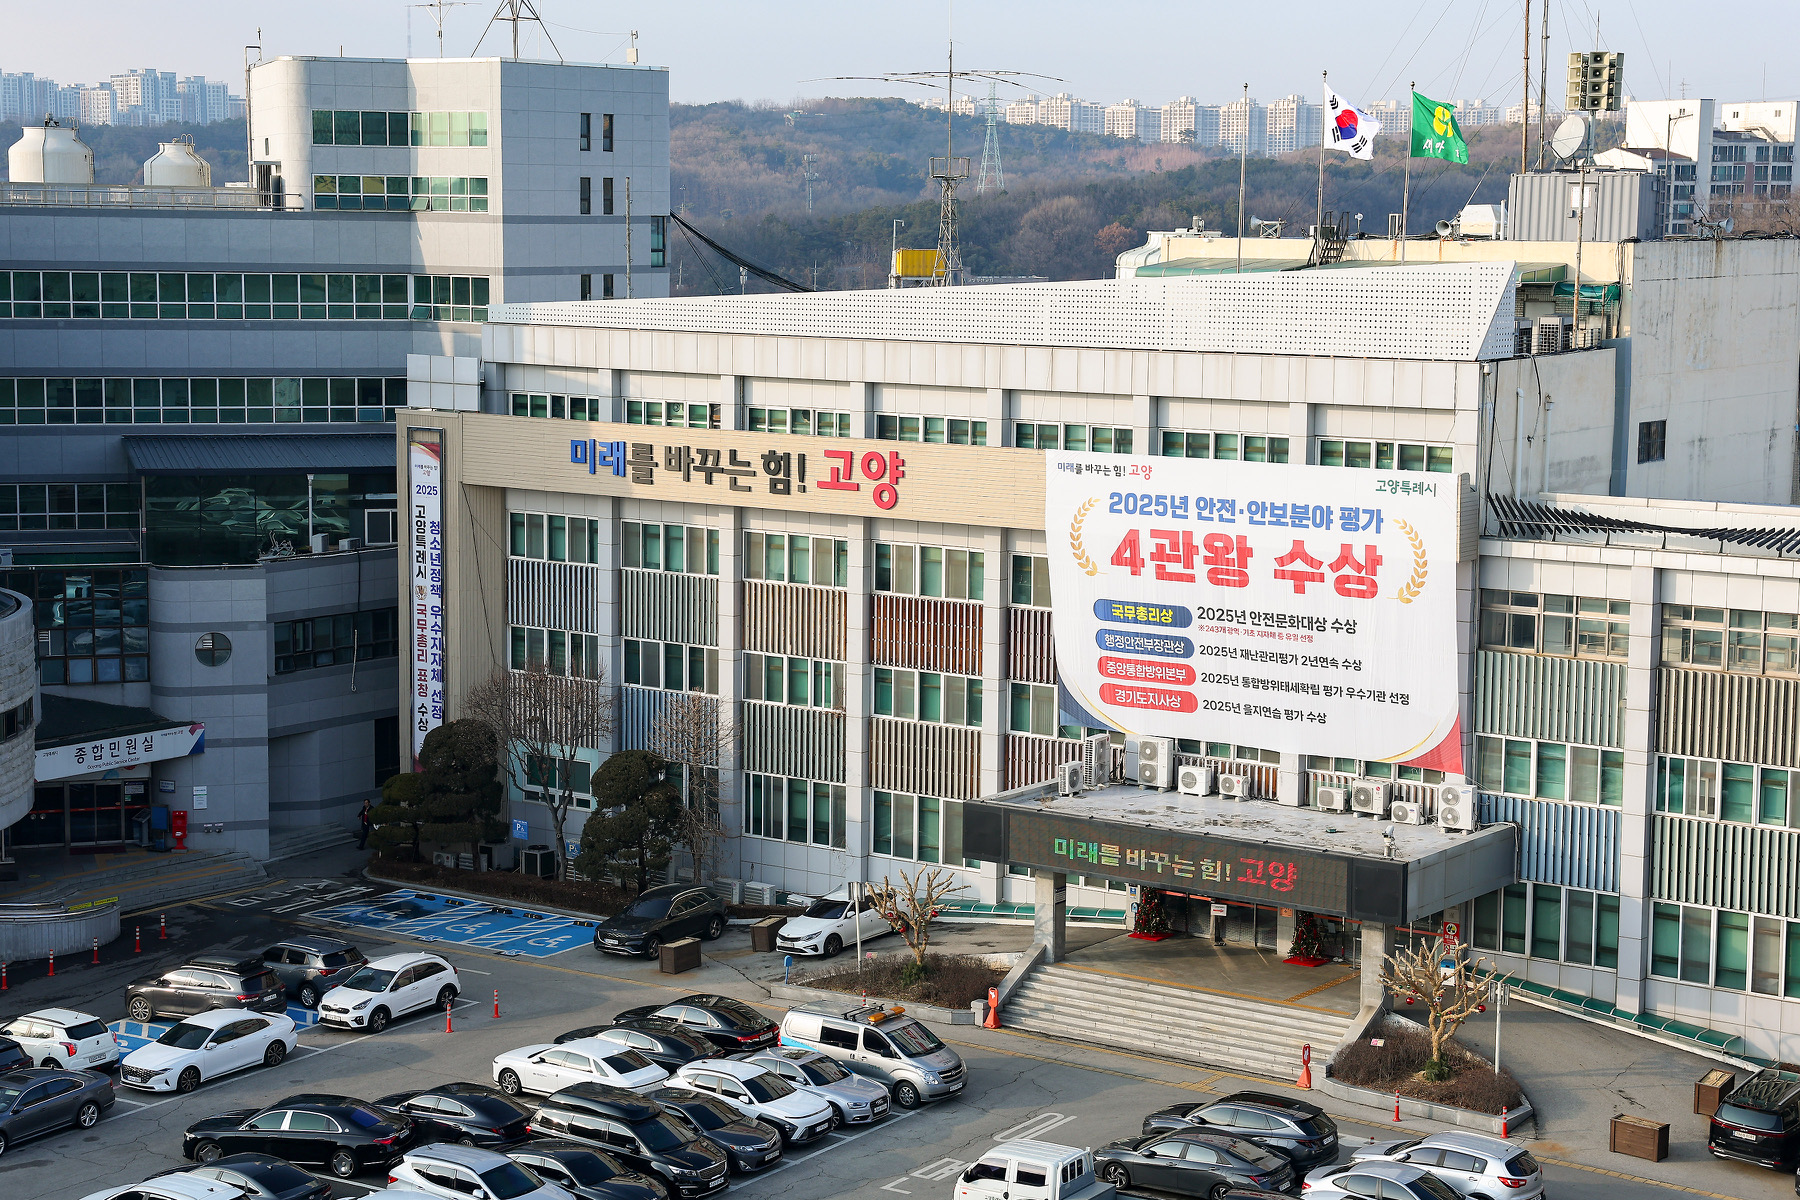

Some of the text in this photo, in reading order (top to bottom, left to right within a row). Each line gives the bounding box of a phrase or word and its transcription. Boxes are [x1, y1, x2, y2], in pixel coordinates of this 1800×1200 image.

[570, 438, 906, 510] 미래를 바꾸는 힘! 고양
[1057, 462, 1153, 480] 미래를 바꾸는 힘! 고양
[415, 484, 438, 496] 2025
[1375, 479, 1437, 498] 고양특례시
[1108, 491, 1384, 535] 2025년 안전·안보분야 평가
[415, 504, 427, 580] 고양특례시
[1110, 528, 1383, 600] 4관왕 수상
[429, 520, 443, 720] 청소년정책 우수지자체 선정
[1111, 604, 1174, 624] 국무총리상
[1196, 606, 1358, 636] 2025년 안전문화대상 수상
[416, 603, 428, 663] 국무총리
[1104, 633, 1185, 655] 행정안전부장관상
[1106, 661, 1187, 682] 중앙통합방위본부
[1199, 644, 1363, 672] 2025년 재난관리평가 2년연속 수상
[417, 668, 428, 698] 표창
[1201, 672, 1410, 706] 2025년 통합방위태세확립 평가 우수기관 선정
[1114, 688, 1182, 709] 경기도지사상
[1202, 699, 1327, 725] 2025년 을지연습 평가 수상
[417, 702, 429, 732] 수상
[74, 735, 154, 765] 종합민원실
[1053, 837, 1298, 893] 미래를 바꾸는 힘! 고양
